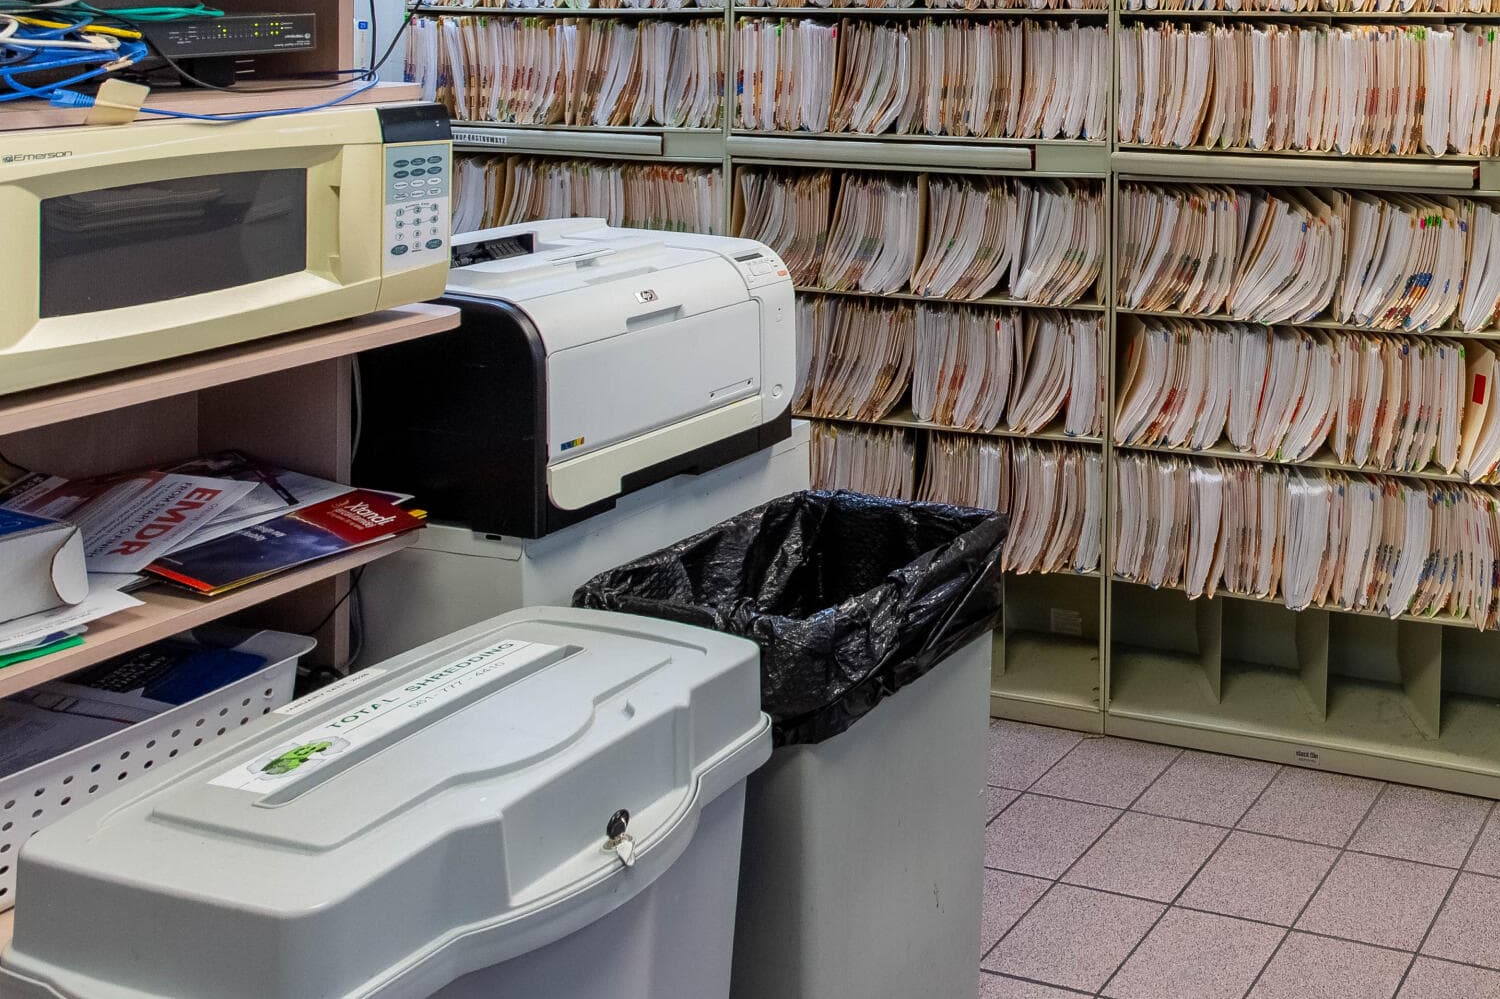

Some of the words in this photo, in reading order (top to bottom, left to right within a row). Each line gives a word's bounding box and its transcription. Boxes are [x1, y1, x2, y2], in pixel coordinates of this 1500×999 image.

[14, 151, 72, 161] Emerson
[104, 487, 223, 556] EMDR
[326, 698, 401, 729] TOTAL
[404, 642, 515, 693] SHREDDING
